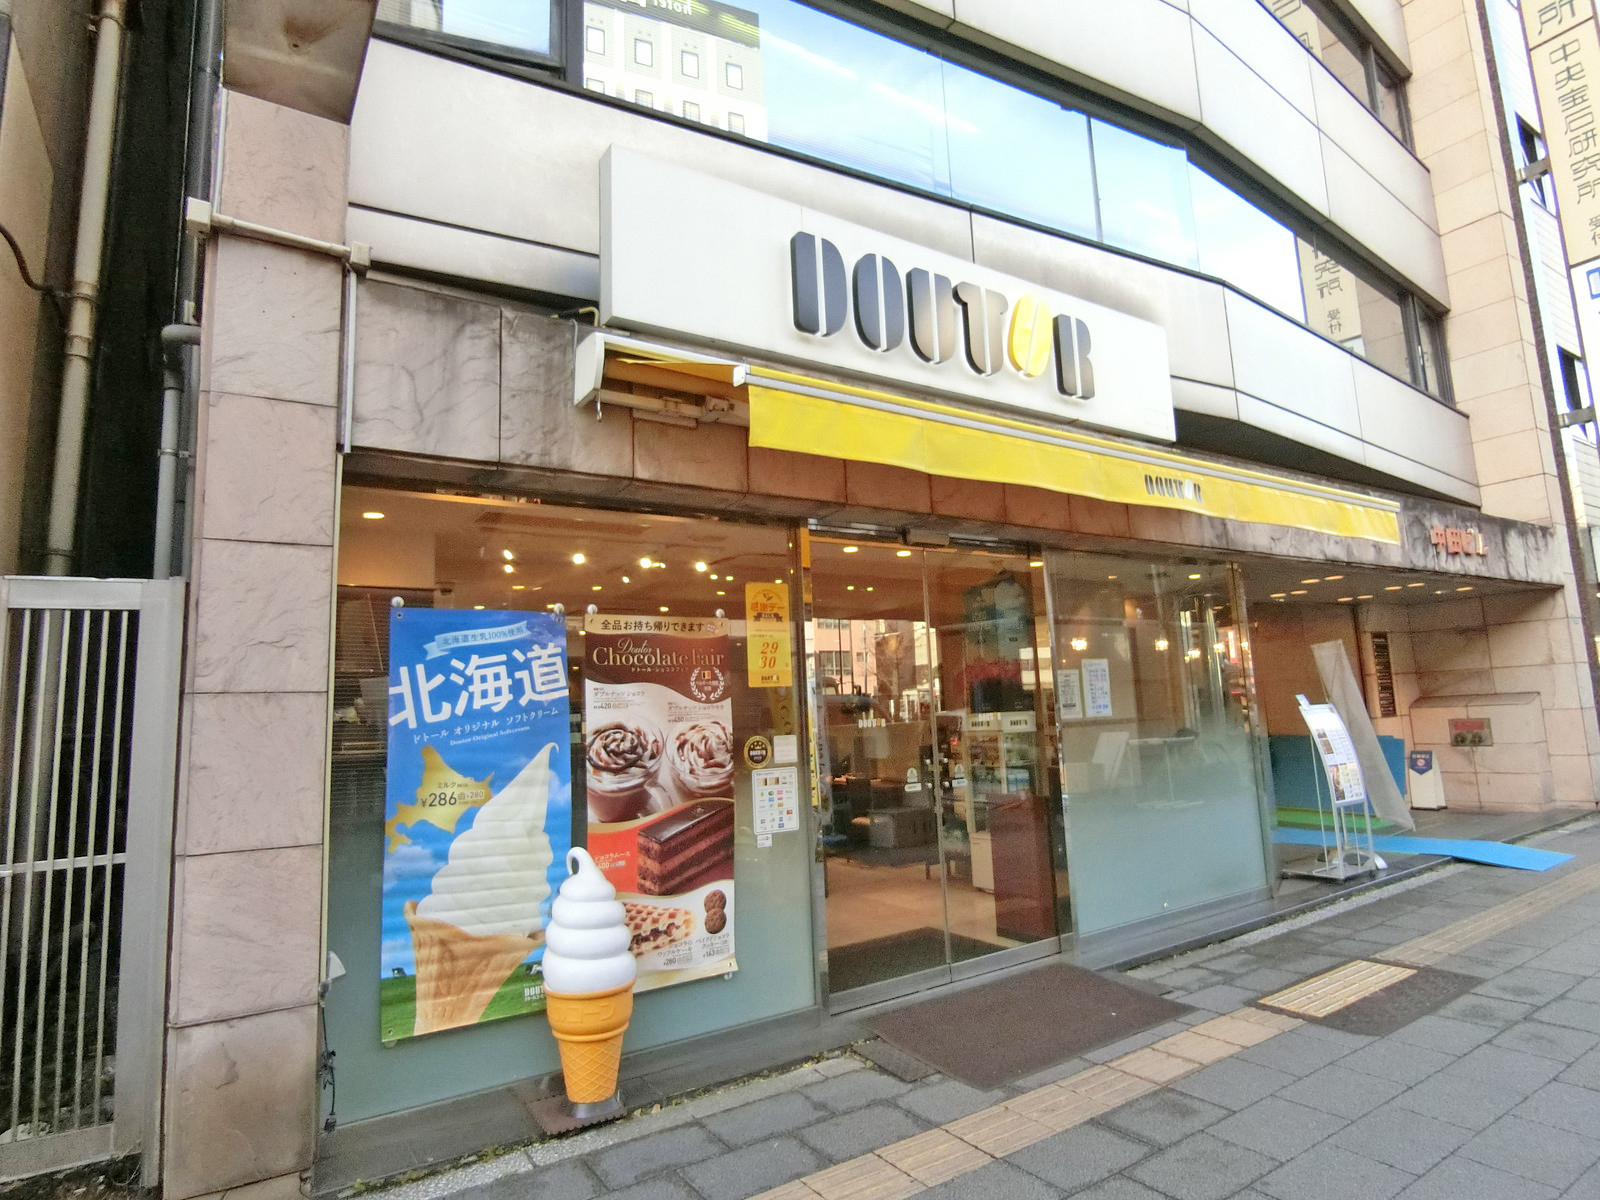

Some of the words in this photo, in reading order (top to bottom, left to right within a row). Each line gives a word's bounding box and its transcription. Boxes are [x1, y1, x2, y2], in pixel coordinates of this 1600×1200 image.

[790, 231, 1096, 401] DOUTOR
[1144, 474, 1203, 504] DOUTOR
[601, 619, 704, 632] 全品お持ち帰りできます
[442, 627, 524, 645] 北海道生乳100%使用
[593, 647, 688, 666] Chocolate
[692, 648, 724, 666] Fair
[389, 642, 569, 729] 北海道
[413, 729, 449, 744] ドトール
[454, 719, 499, 735] オリジナル
[506, 708, 559, 725] ソフトクリーム
[421, 792, 457, 807] ¥286
[524, 985, 545, 996] DOUT
